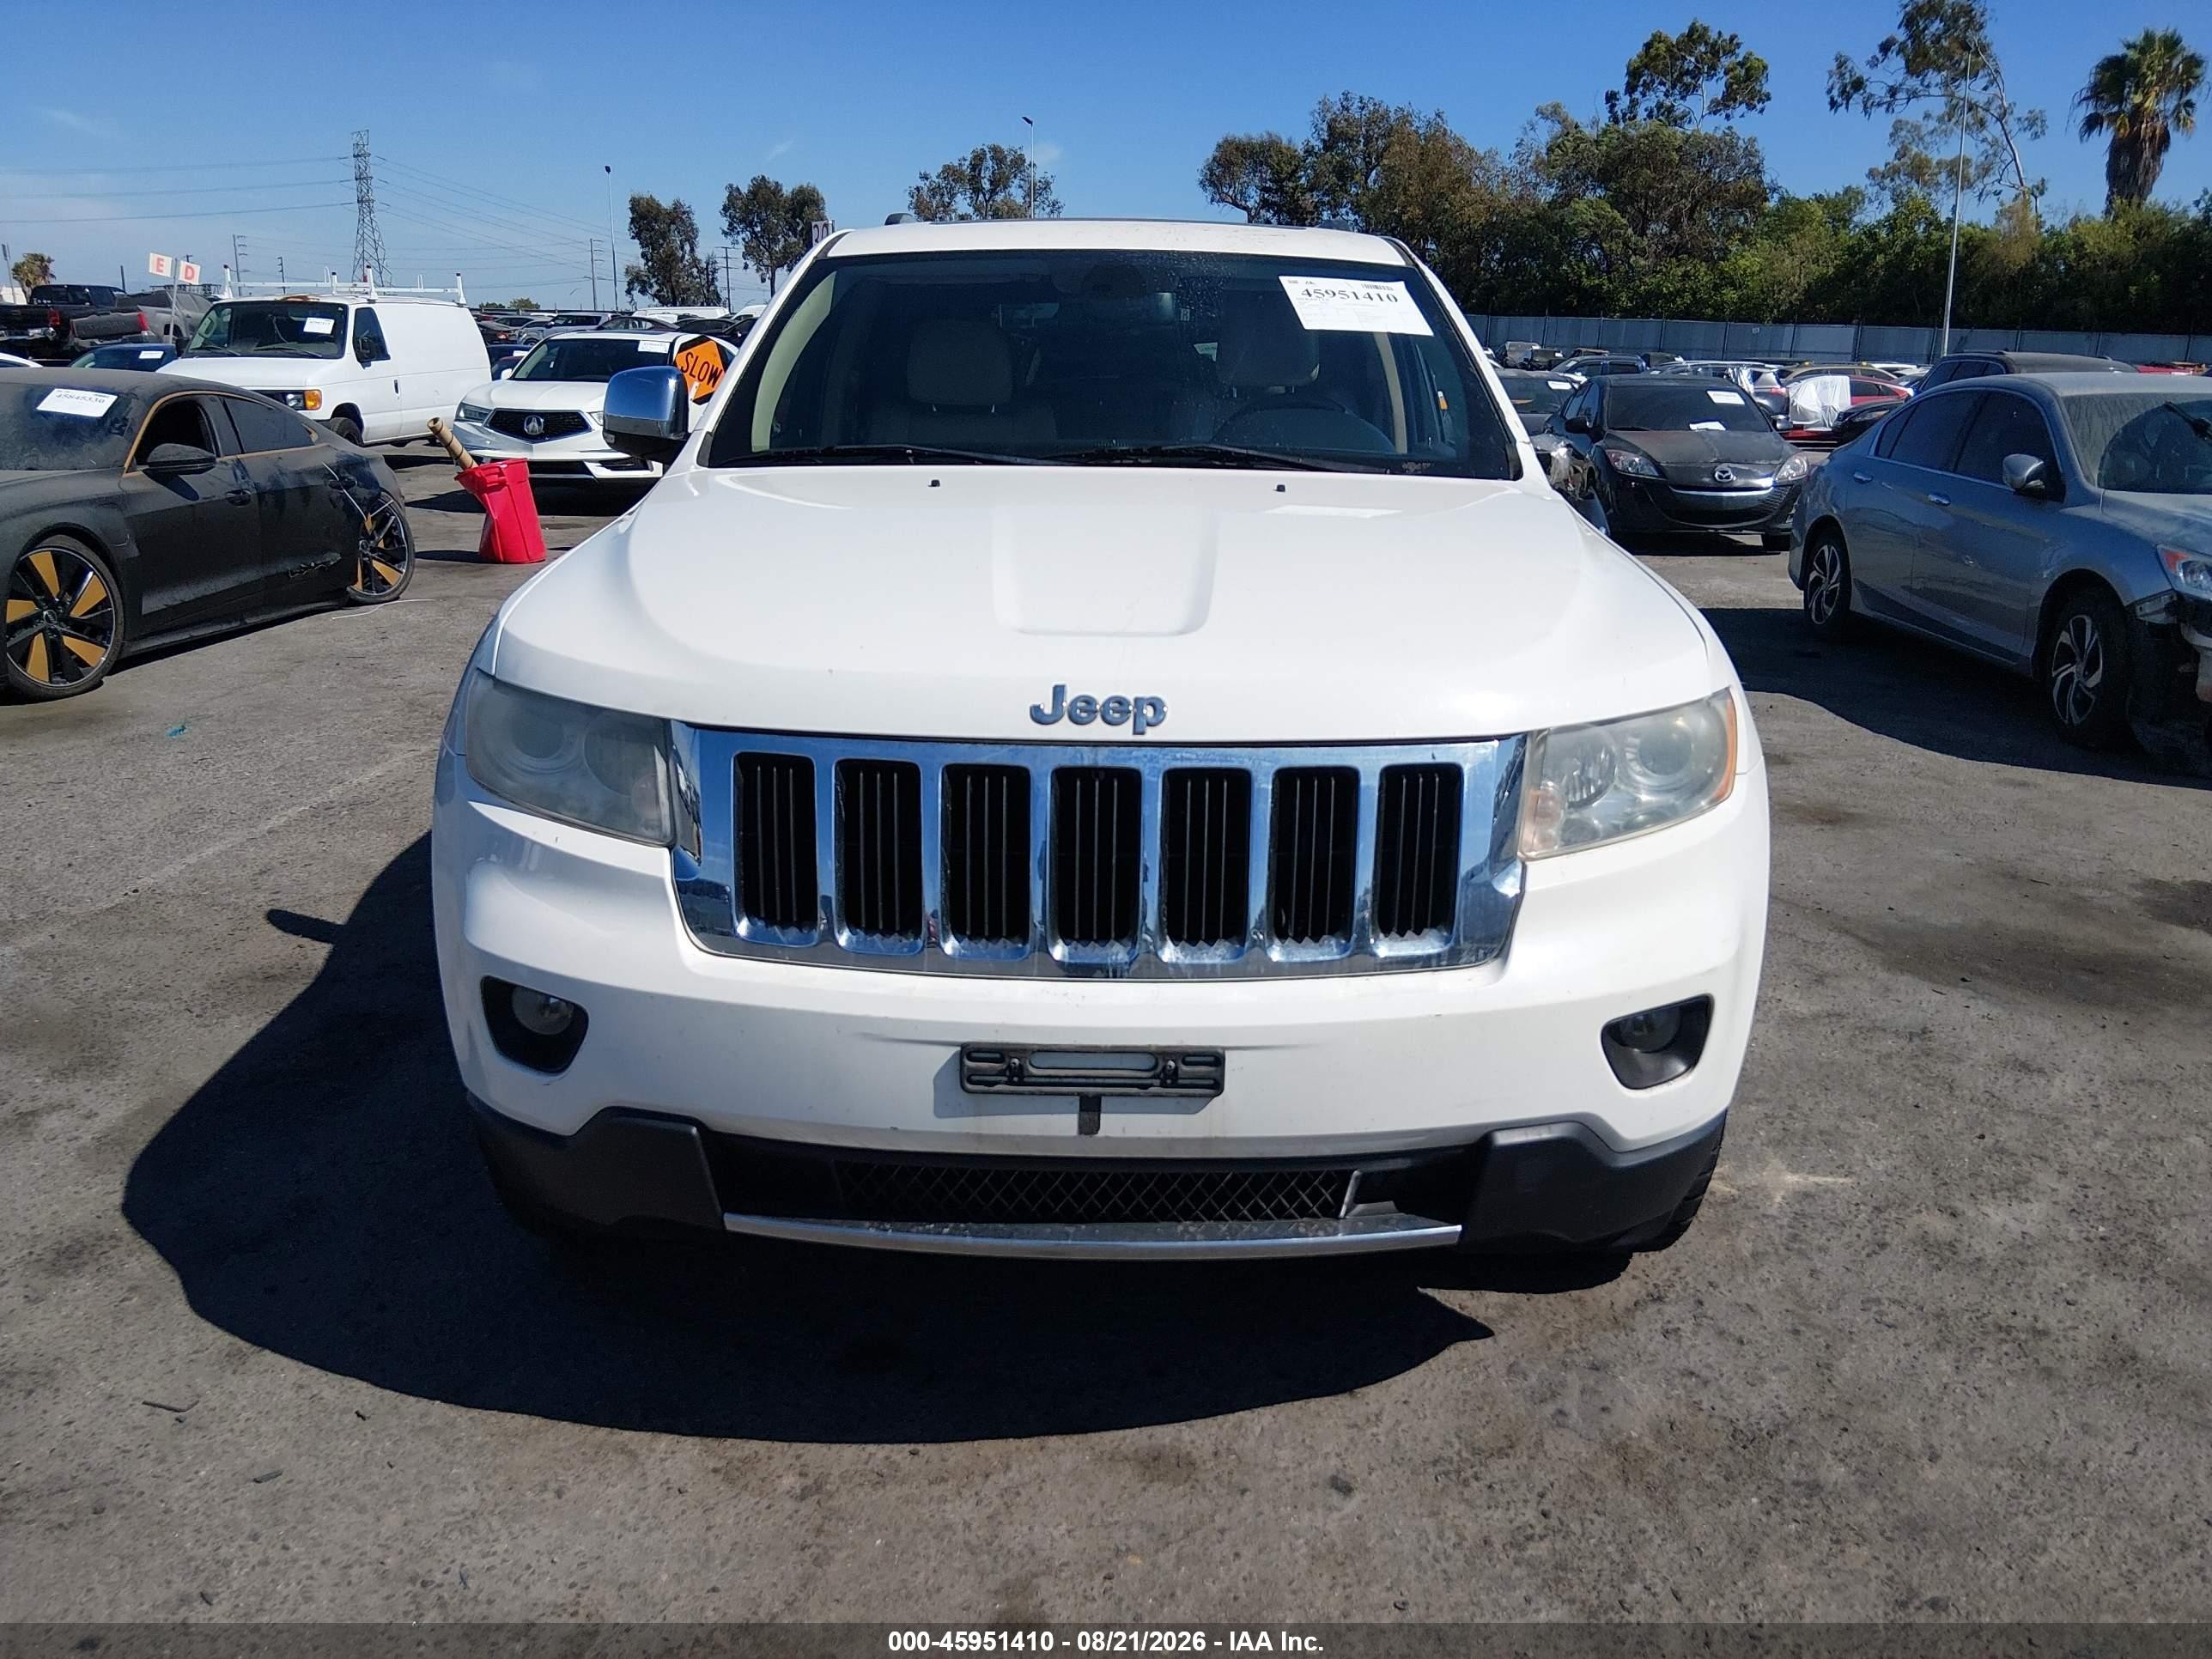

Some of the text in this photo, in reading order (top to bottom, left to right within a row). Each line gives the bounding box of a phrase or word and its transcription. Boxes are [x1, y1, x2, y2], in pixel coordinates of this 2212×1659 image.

[155, 257, 165, 273] E
[184, 264, 195, 280] D
[1300, 288, 1399, 303] 45951410
[680, 351, 723, 388] SLOW
[1030, 684, 1168, 736] Jeep
